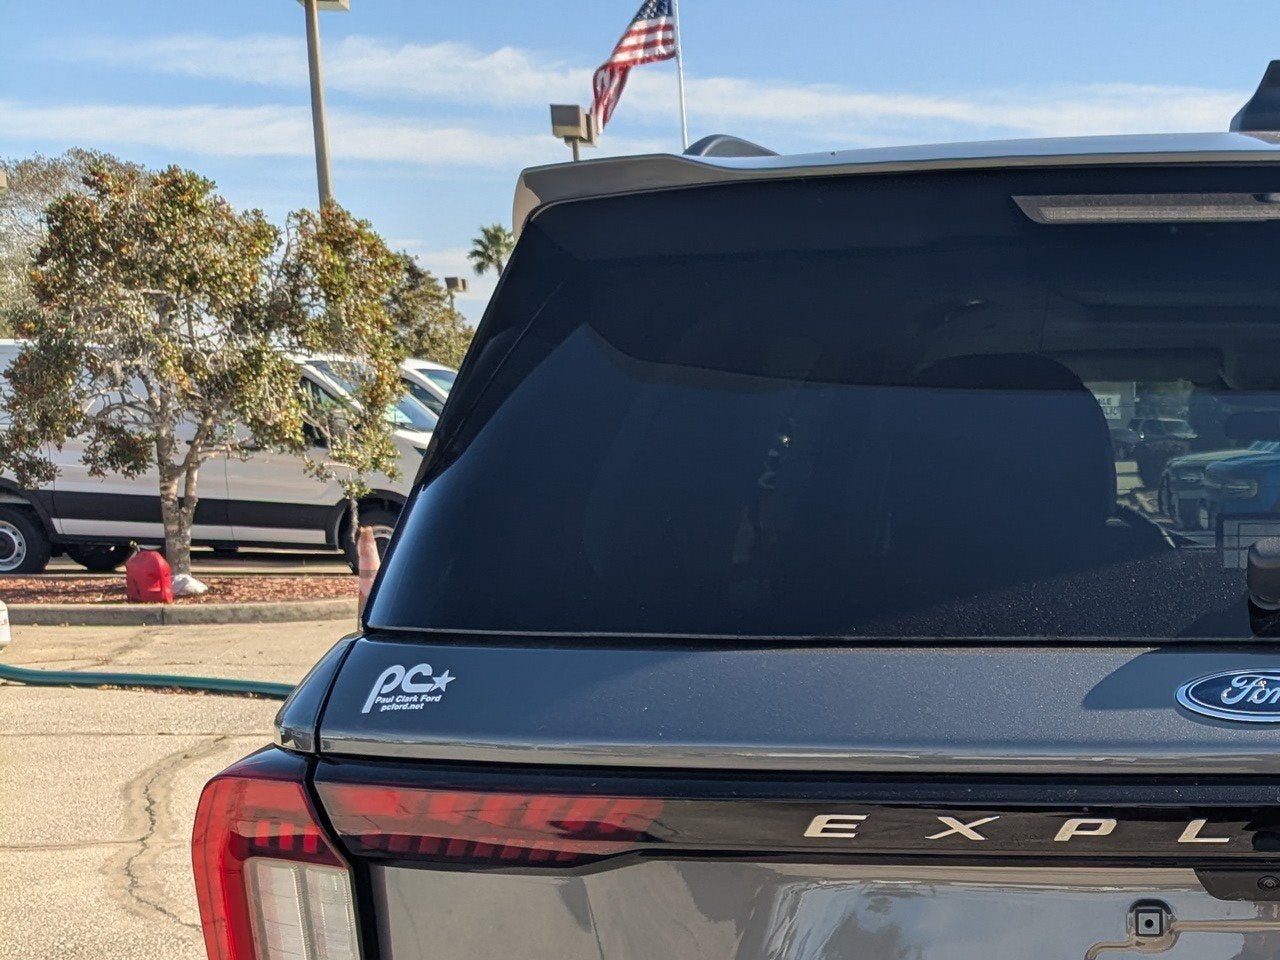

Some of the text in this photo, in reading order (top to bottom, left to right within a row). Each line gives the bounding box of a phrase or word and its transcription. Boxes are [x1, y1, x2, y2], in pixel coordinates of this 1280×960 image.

[375, 694, 442, 704] Paul Clark Ford
[380, 702, 425, 712] pcford.net
